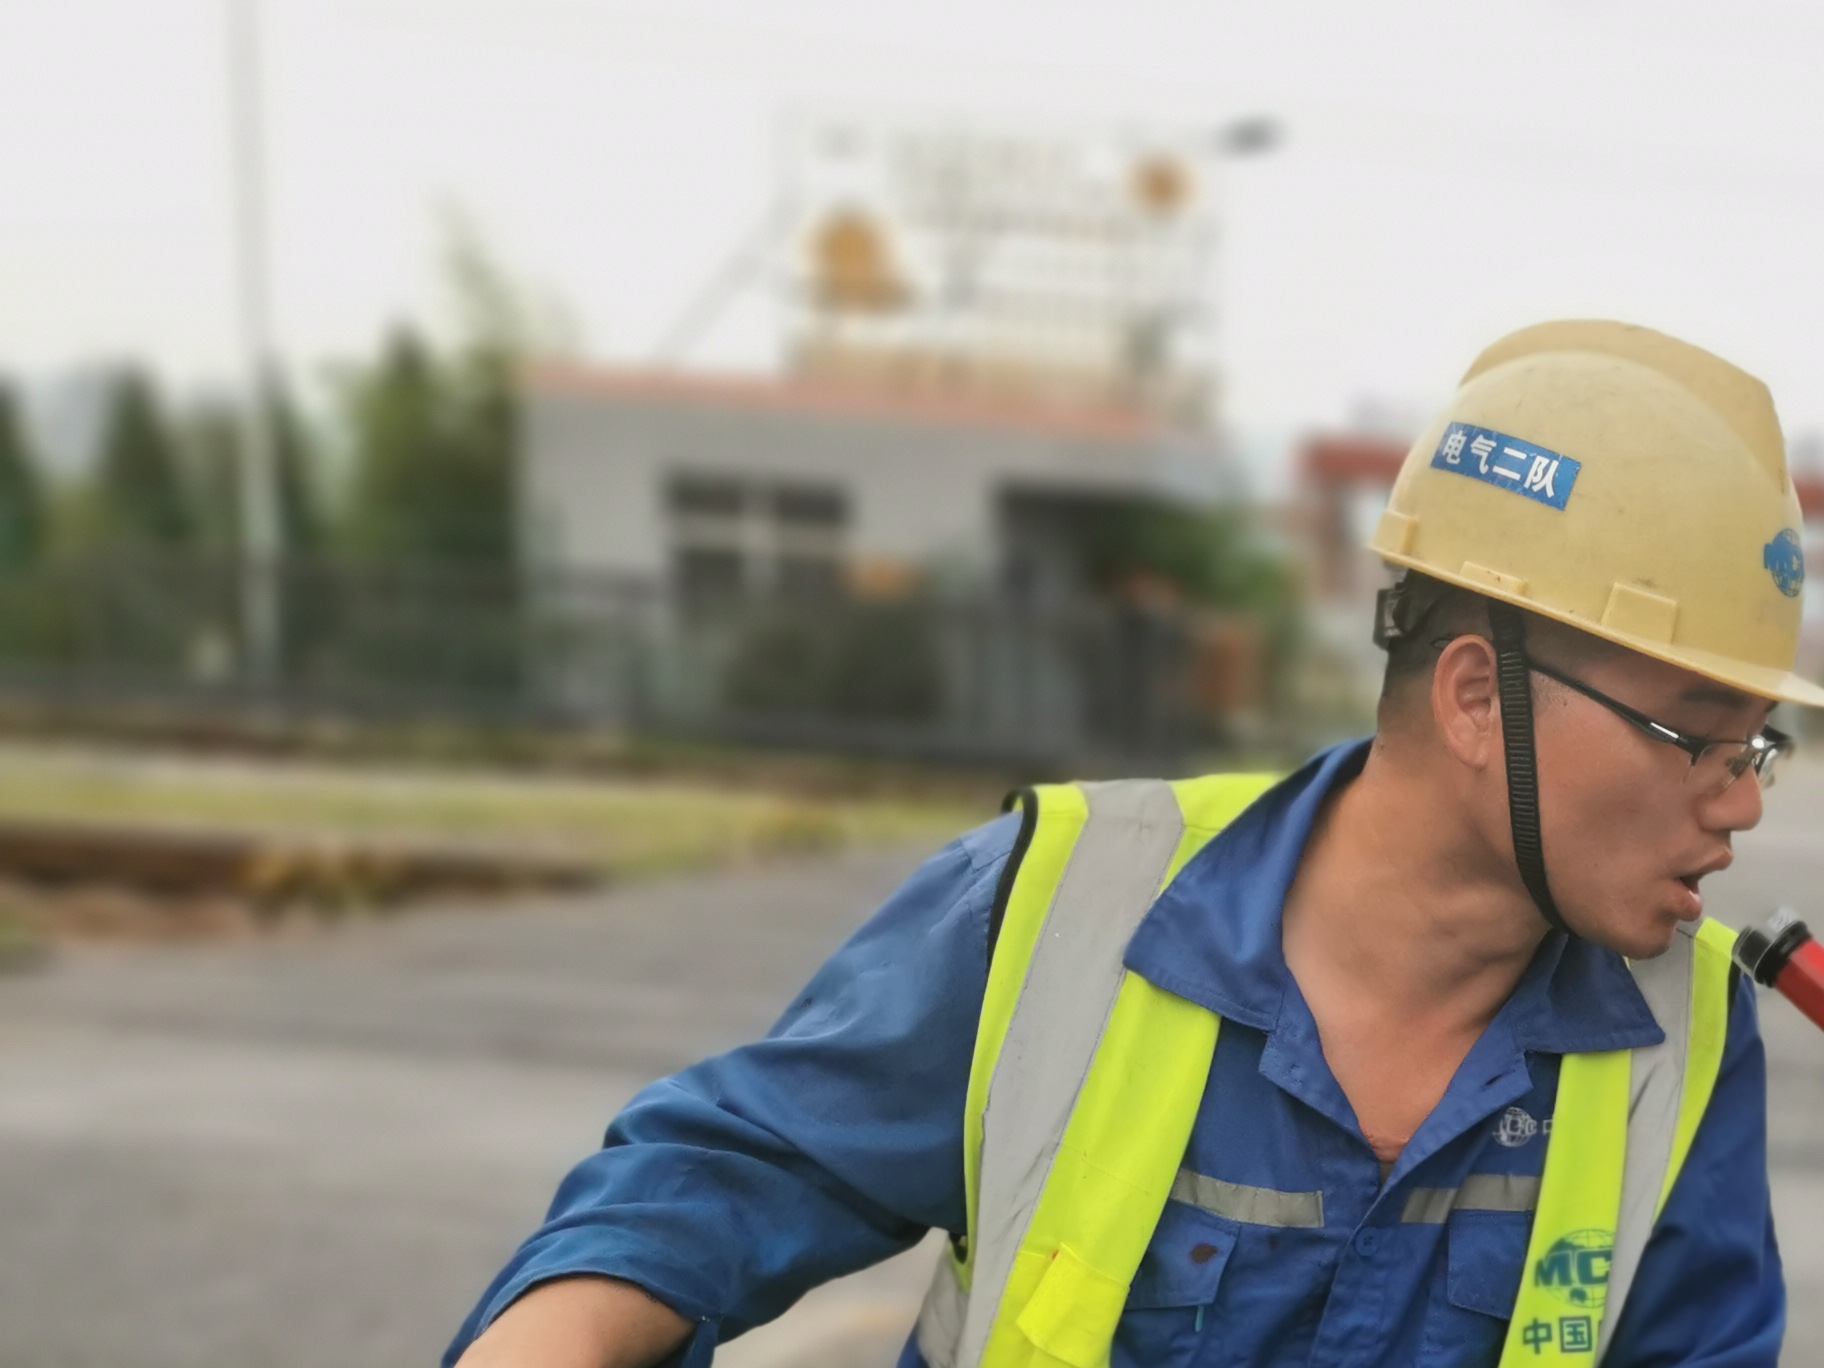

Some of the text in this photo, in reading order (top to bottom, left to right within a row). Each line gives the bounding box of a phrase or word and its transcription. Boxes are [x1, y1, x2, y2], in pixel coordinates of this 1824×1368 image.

[1442, 430, 1561, 498] 电气二队
[1522, 1315, 1603, 1355] 中国
